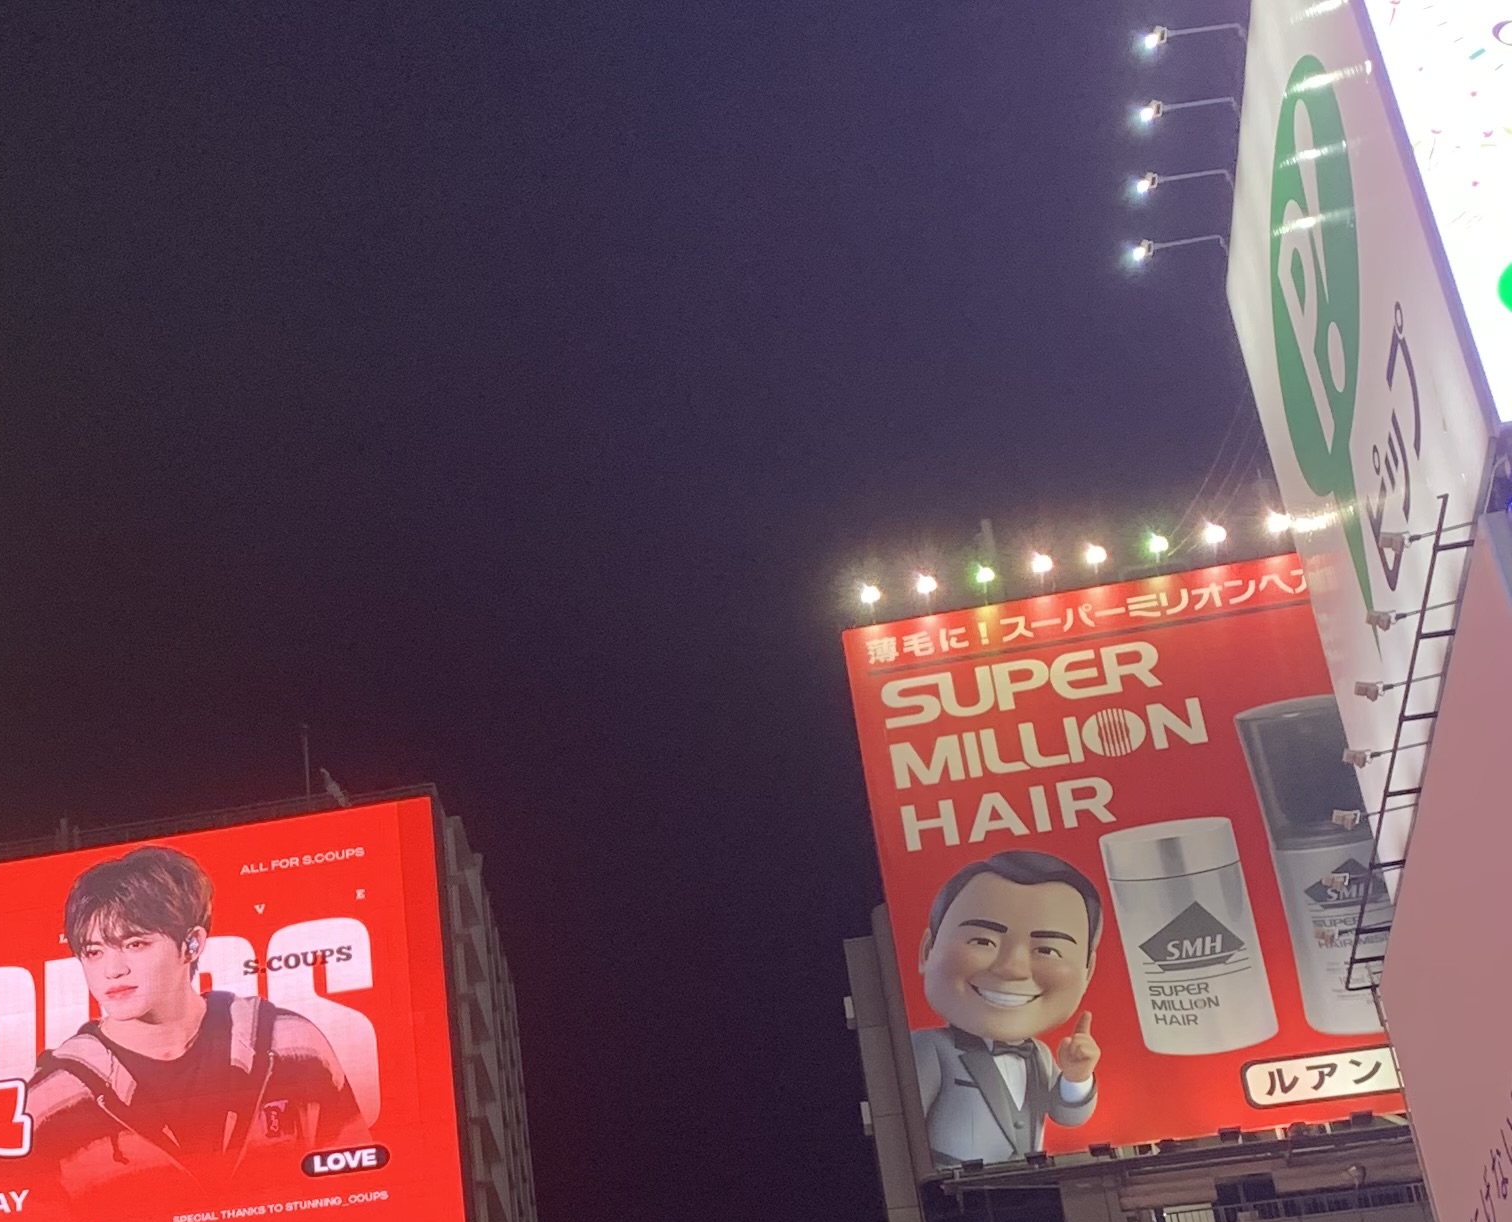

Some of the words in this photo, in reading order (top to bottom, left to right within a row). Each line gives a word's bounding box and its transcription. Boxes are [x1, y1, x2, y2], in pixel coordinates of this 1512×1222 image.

[879, 640, 1162, 730] SUPER
[889, 697, 1209, 790] MILLION
[899, 776, 1117, 853] HAIR
[240, 862, 268, 875] ALL
[271, 856, 299, 870] FOR
[302, 847, 365, 865] S.COUPS
[254, 903, 265, 914] V
[355, 889, 365, 900] E
[1166, 934, 1223, 960] SMH
[243, 945, 353, 976] S.COUPS
[1148, 982, 1210, 997] SUPER
[1151, 995, 1220, 1012] MILLION
[1154, 1012, 1199, 1026] HAIR
[1263, 1058, 1382, 1097] ルアン
[313, 1148, 378, 1173] LOVE
[221, 1205, 266, 1219] THANKS
[268, 1203, 283, 1214] TO
